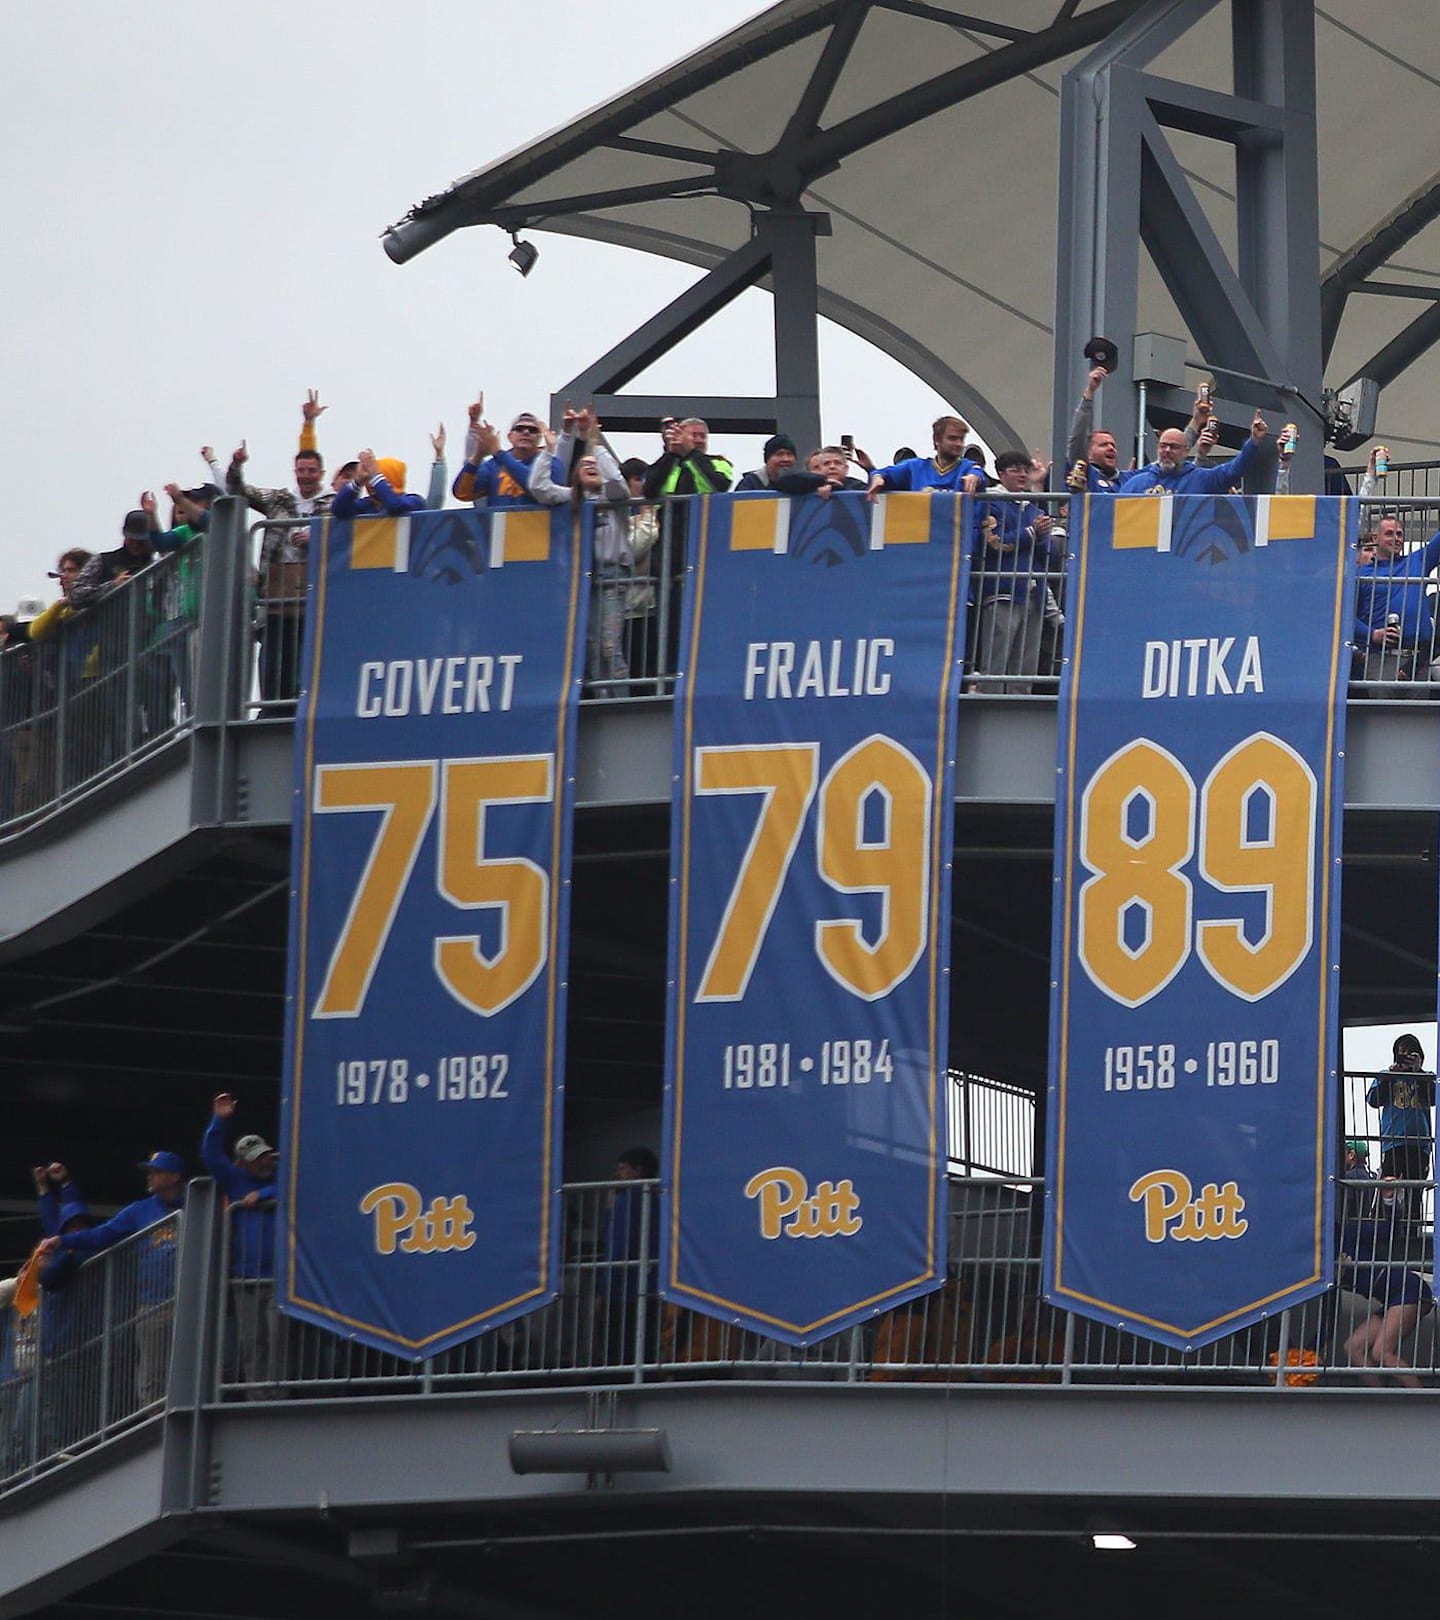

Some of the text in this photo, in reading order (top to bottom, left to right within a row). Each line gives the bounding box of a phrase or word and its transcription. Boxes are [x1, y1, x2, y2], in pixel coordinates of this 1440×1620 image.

[358, 656, 522, 717] COVERT
[745, 639, 894, 699] FRALIC
[1142, 636, 1263, 698] DITKA
[311, 753, 555, 1019] 75
[694, 733, 932, 1003] 79
[1078, 730, 1317, 1008] 89
[338, 1055, 507, 1104] 1978 1982
[725, 1040, 892, 1088] 1981 1984
[1106, 1040, 1278, 1091] 1958 1960
[359, 1183, 476, 1254] Pitt
[745, 1167, 862, 1239] Pitt
[1129, 1169, 1248, 1242] Pitt
